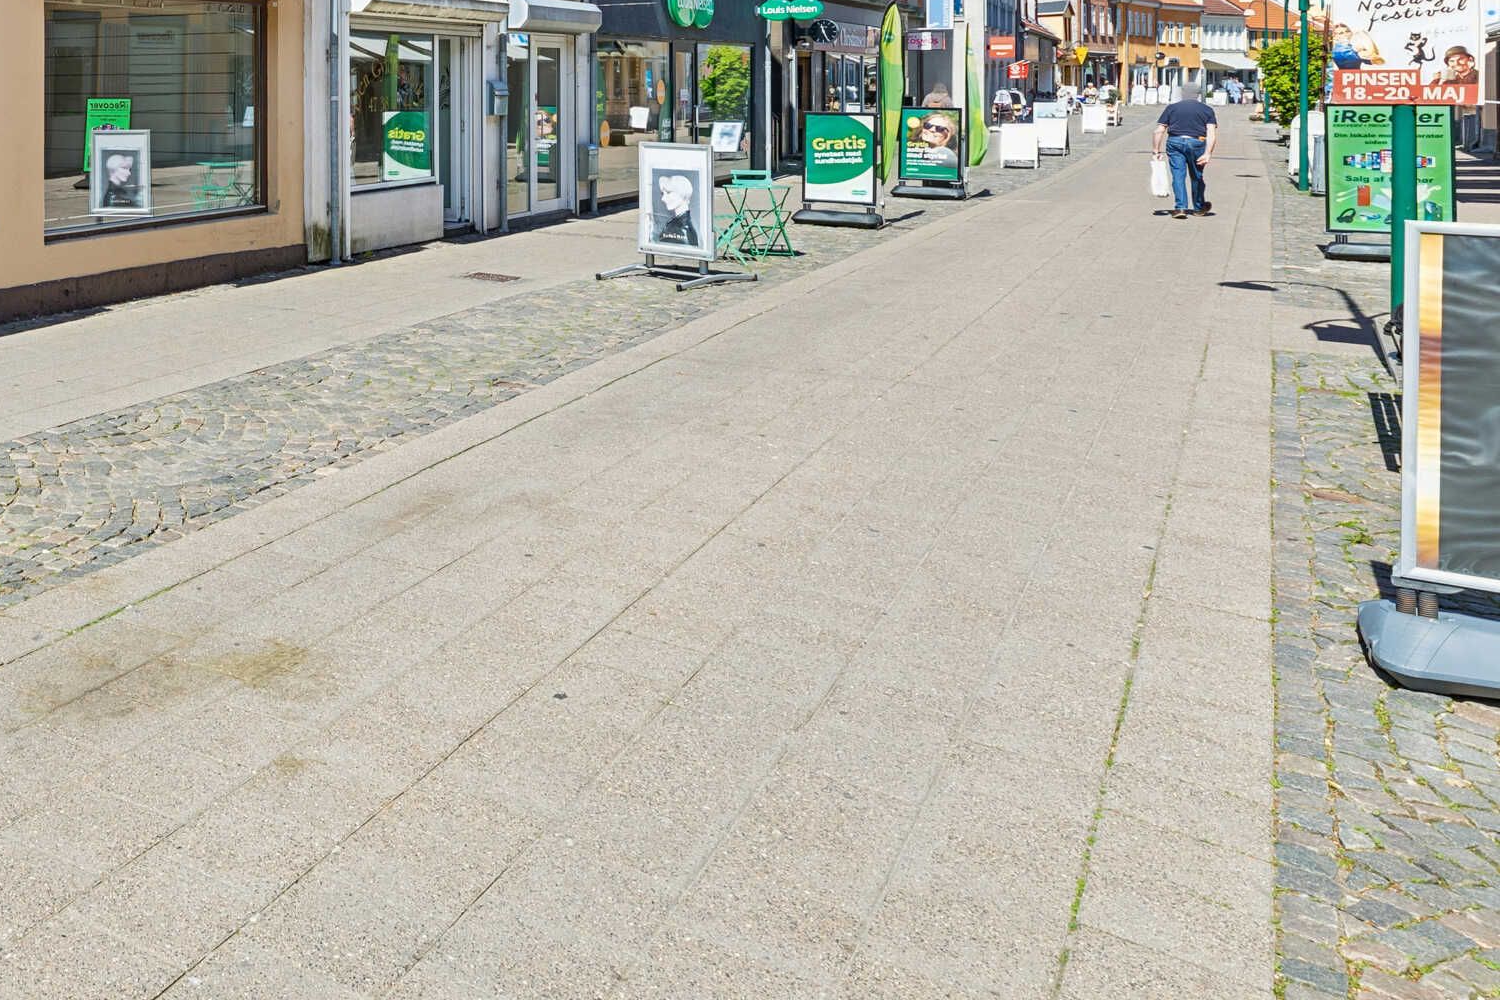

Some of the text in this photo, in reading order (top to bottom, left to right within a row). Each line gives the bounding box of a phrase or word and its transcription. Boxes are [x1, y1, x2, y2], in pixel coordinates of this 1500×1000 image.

[762, 5, 818, 14] Louis Nielsen
[1341, 72, 1418, 86] PINSEN
[1422, 86, 1466, 104] MAJ
[1333, 109, 1445, 123] iRecer
[812, 135, 867, 151] Gratis
[1345, 175, 1370, 184] Salg
